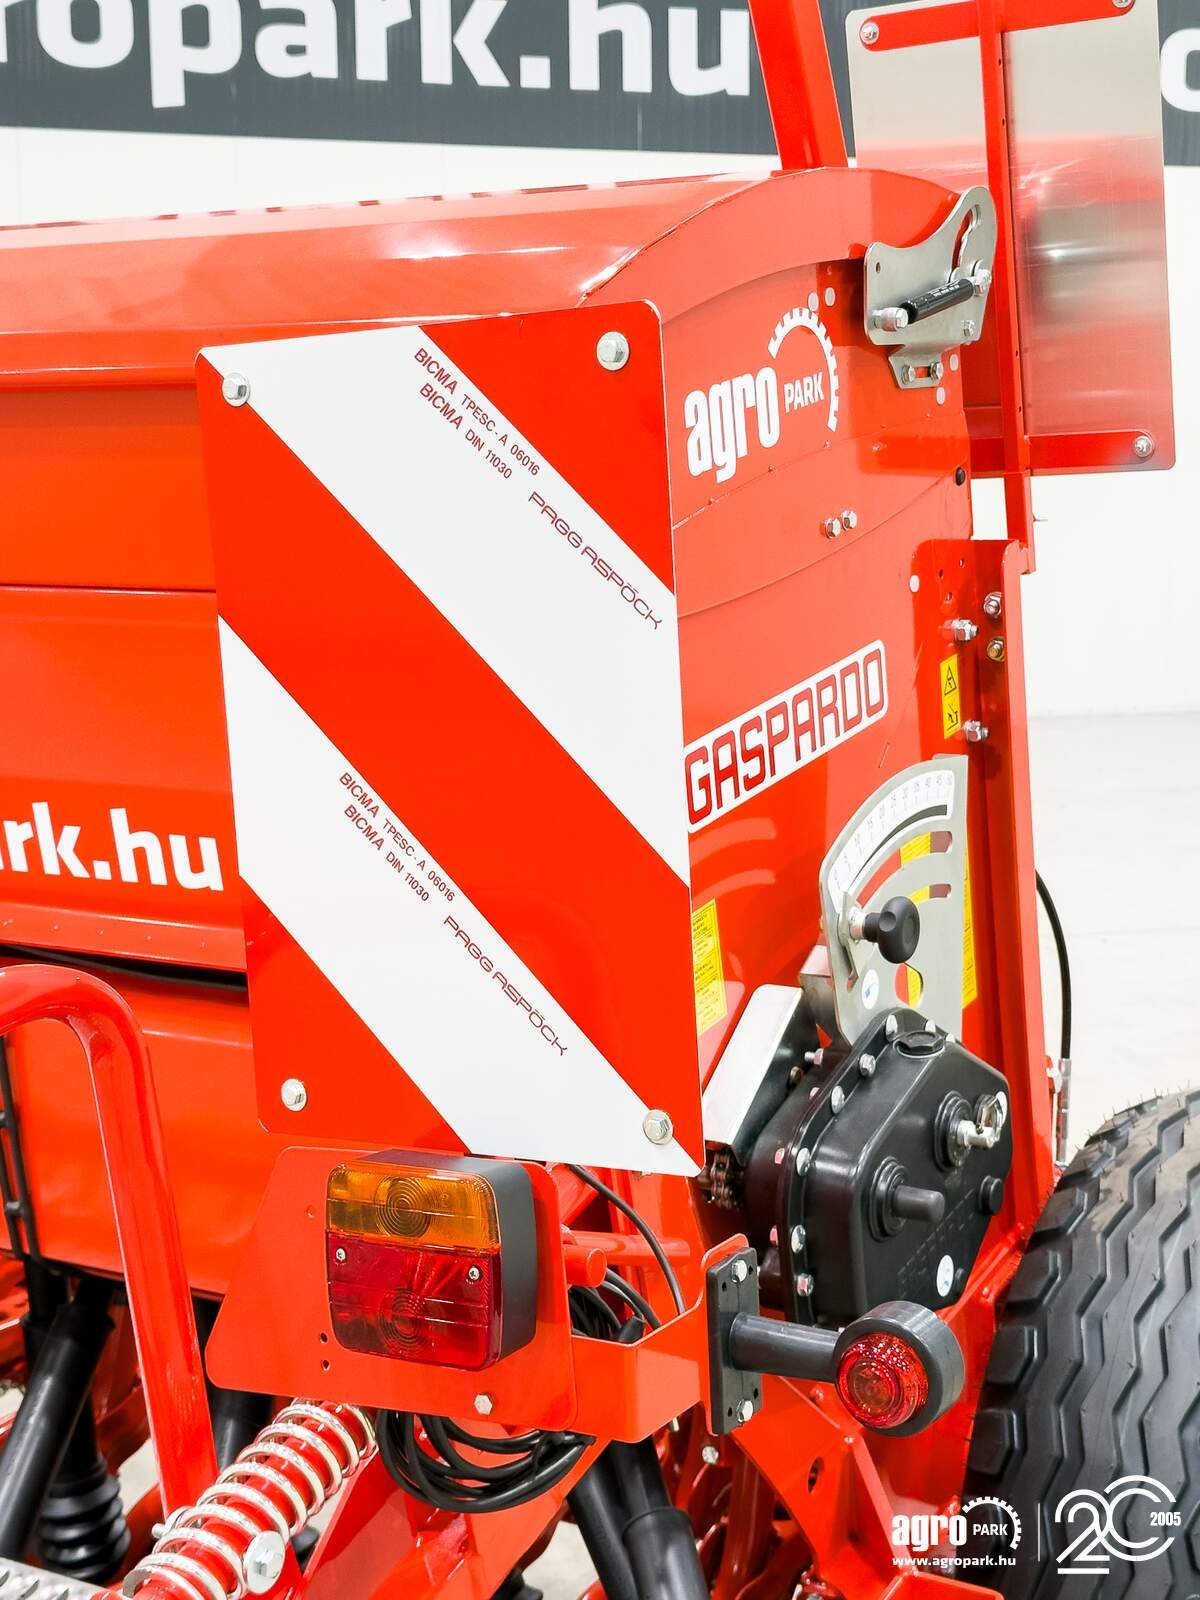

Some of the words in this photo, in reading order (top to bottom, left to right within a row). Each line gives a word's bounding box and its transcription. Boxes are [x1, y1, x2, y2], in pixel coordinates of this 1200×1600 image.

[0, 0, 750, 109] opark.hu
[414, 348, 458, 395] BICMA
[510, 444, 540, 476] 06016
[419, 383, 463, 430] BICMA
[464, 429, 486, 452] DIN
[485, 449, 513, 480] 11030
[684, 366, 780, 483] agro
[784, 372, 824, 413] PARK
[685, 648, 885, 825] GASPARDO
[0, 801, 224, 892] rk.hu
[339, 772, 380, 818] BICMA
[427, 870, 456, 902] 06016
[344, 804, 385, 851] BICMA
[386, 851, 404, 873] DIN
[404, 872, 430, 902] 11030
